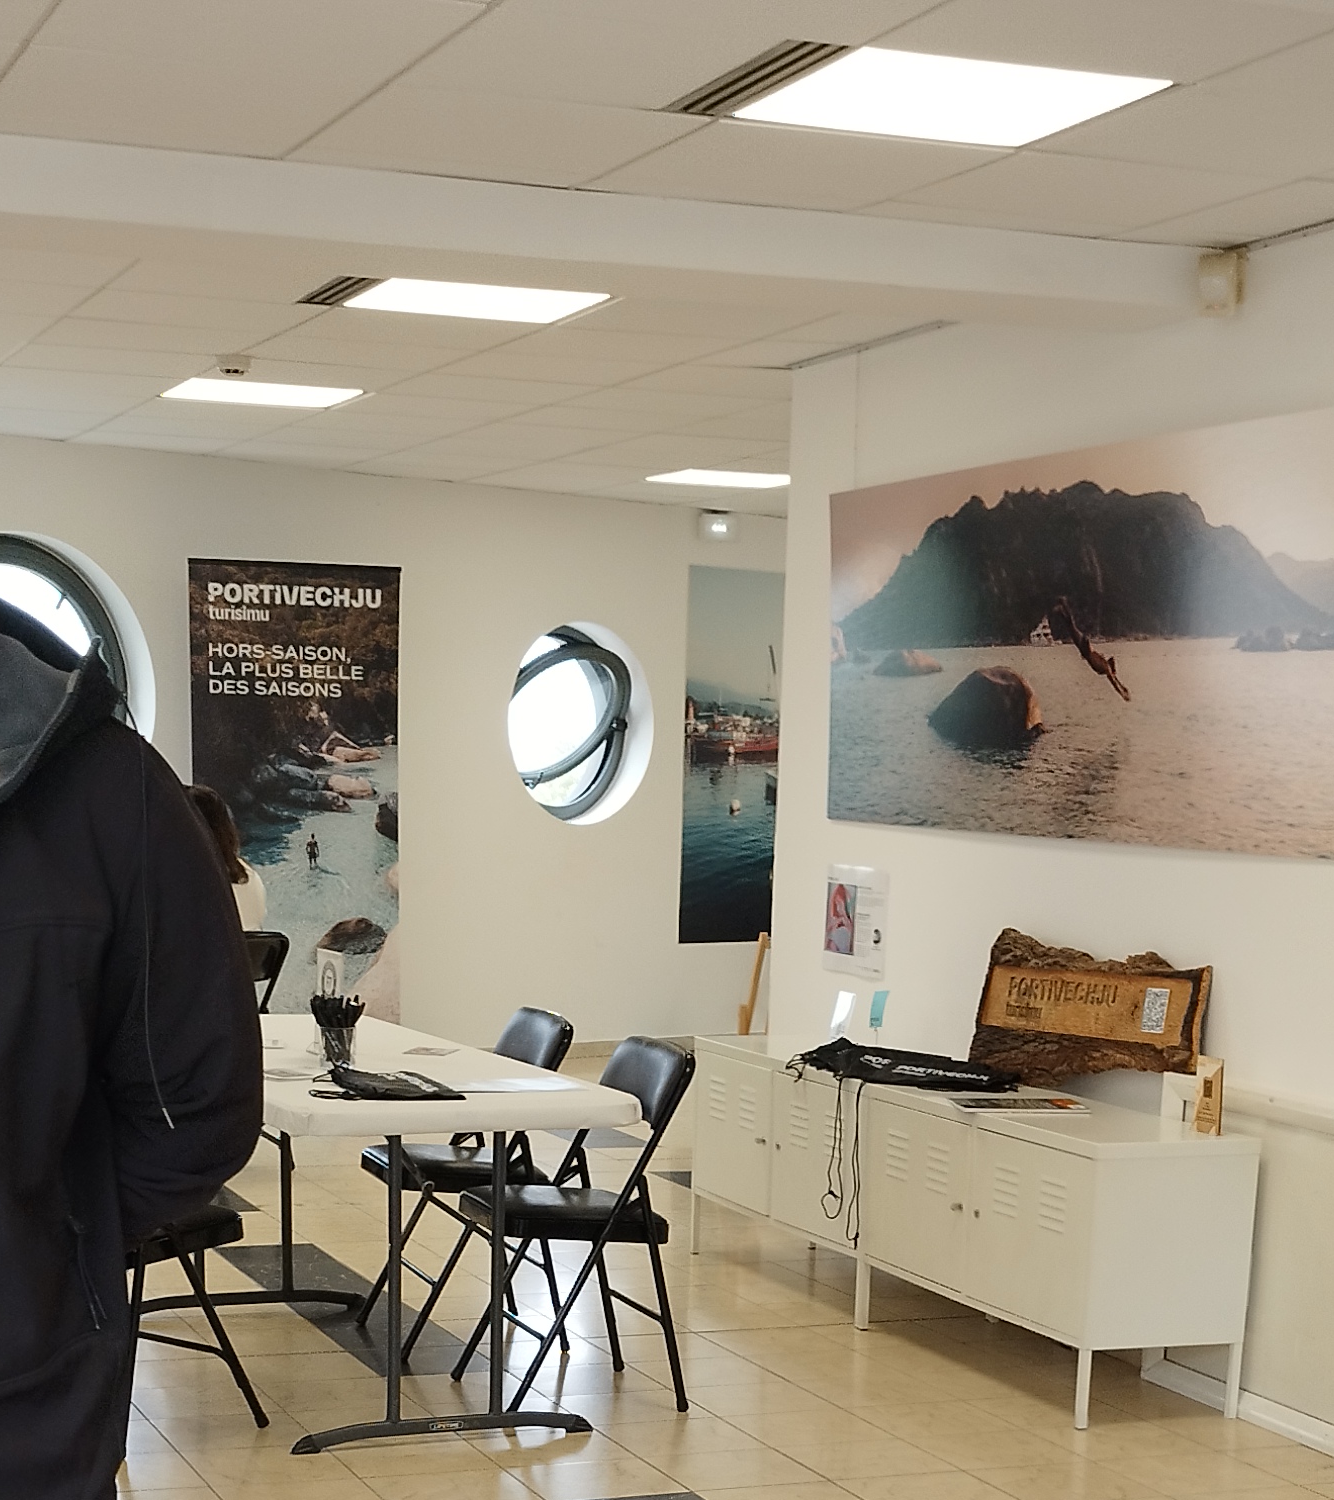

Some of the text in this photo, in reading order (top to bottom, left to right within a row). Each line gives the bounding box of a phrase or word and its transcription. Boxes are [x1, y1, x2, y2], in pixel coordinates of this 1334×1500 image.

[207, 582, 382, 609] PORTIVECHJU
[208, 643, 352, 664] HORS-SAISON,
[209, 661, 364, 680] LA PLUS BELLE
[209, 679, 342, 698] DES SAISONS
[1007, 976, 1119, 1007] PORTIVECHJU
